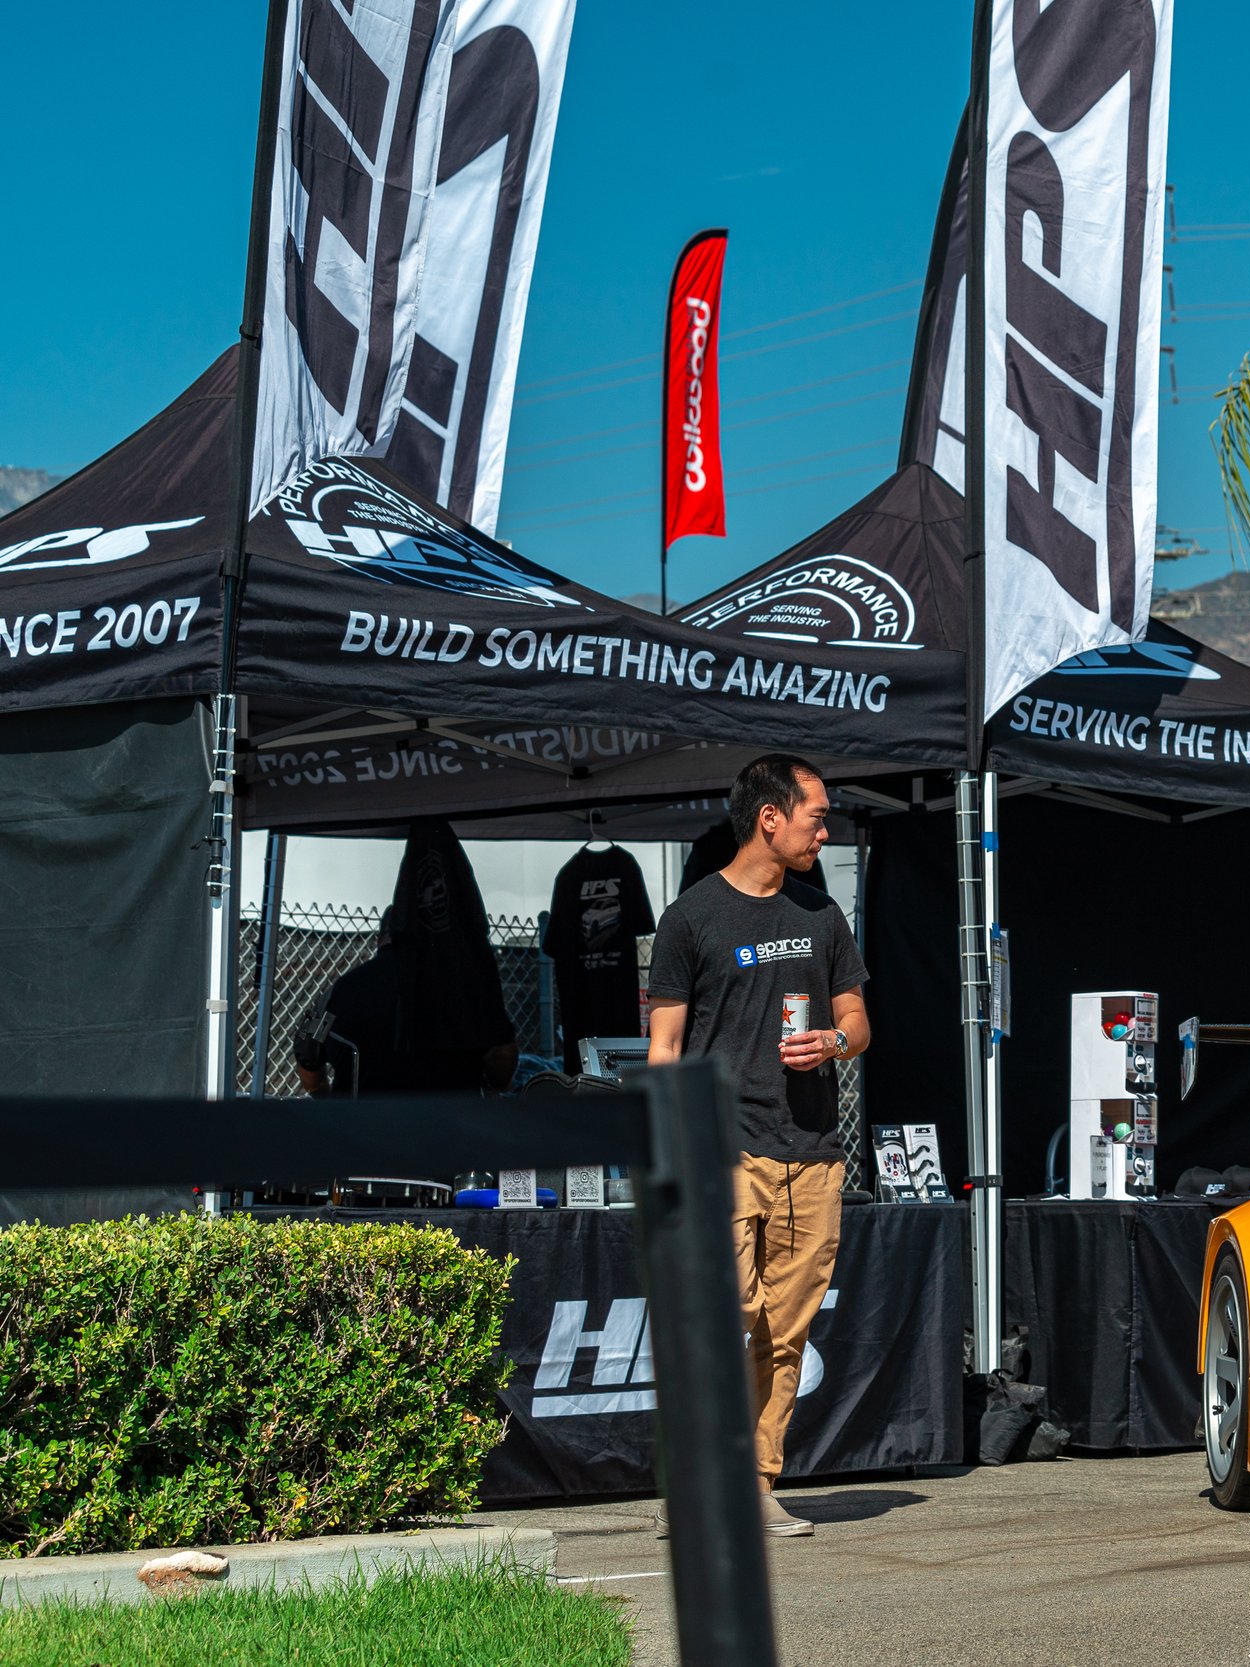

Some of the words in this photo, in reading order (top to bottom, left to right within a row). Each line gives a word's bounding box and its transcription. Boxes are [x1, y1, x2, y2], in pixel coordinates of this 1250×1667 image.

[682, 296, 712, 493] wilwood
[769, 604, 822, 616] SERVING
[87, 596, 201, 651] 2007
[747, 615, 772, 624] THE
[773, 617, 831, 629] INDUSTRY
[340, 610, 475, 663] BUILD
[477, 626, 717, 690] SOMETHING
[720, 656, 892, 713] AMAZING
[1009, 694, 1151, 751] SERVING
[1158, 719, 1217, 761] THE
[580, 878, 621, 899] HPS
[755, 938, 812, 957] sparco
[882, 1129, 900, 1138] HPS
